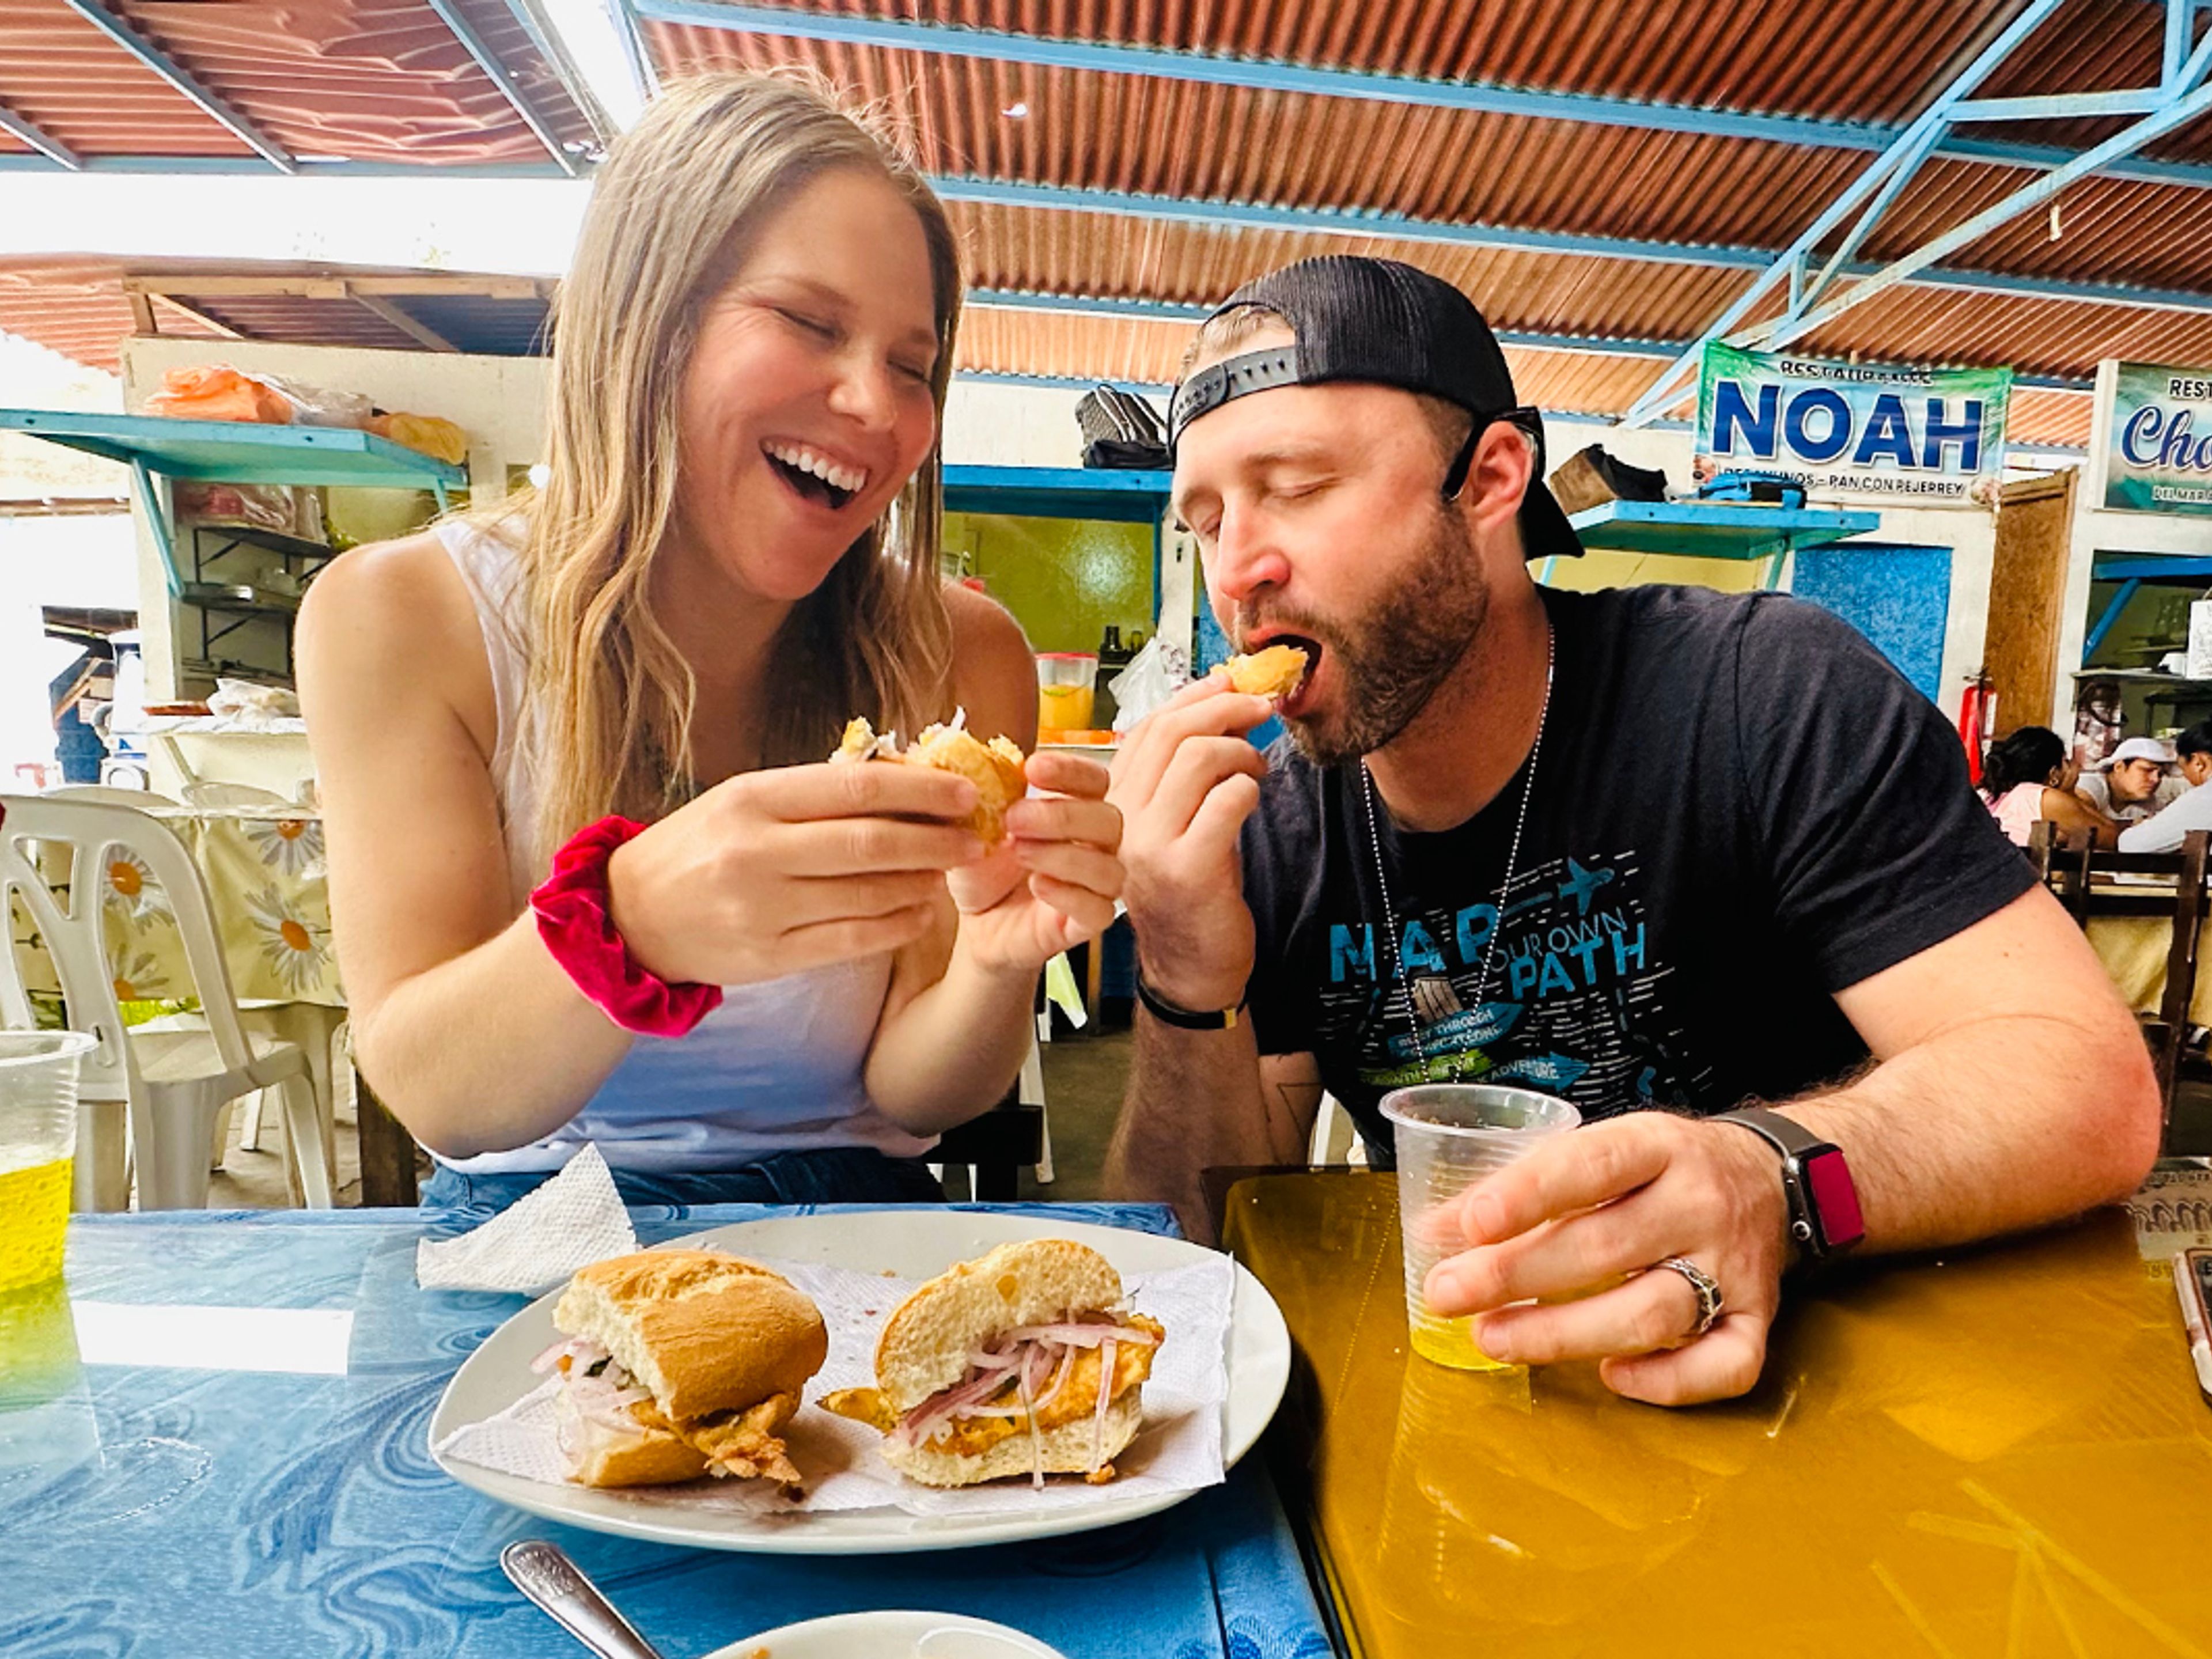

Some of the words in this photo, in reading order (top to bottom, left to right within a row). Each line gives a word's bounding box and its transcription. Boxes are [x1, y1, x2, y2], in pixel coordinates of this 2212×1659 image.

[1711, 379, 1984, 472] NOAH
[1829, 475, 1858, 488] PAN
[1862, 476, 1893, 490] CON
[1896, 479, 1963, 494] PEJERREY
[1330, 903, 1499, 982] MAP
[1509, 922, 1645, 999] PATH
[1548, 906, 1628, 953] OWN
